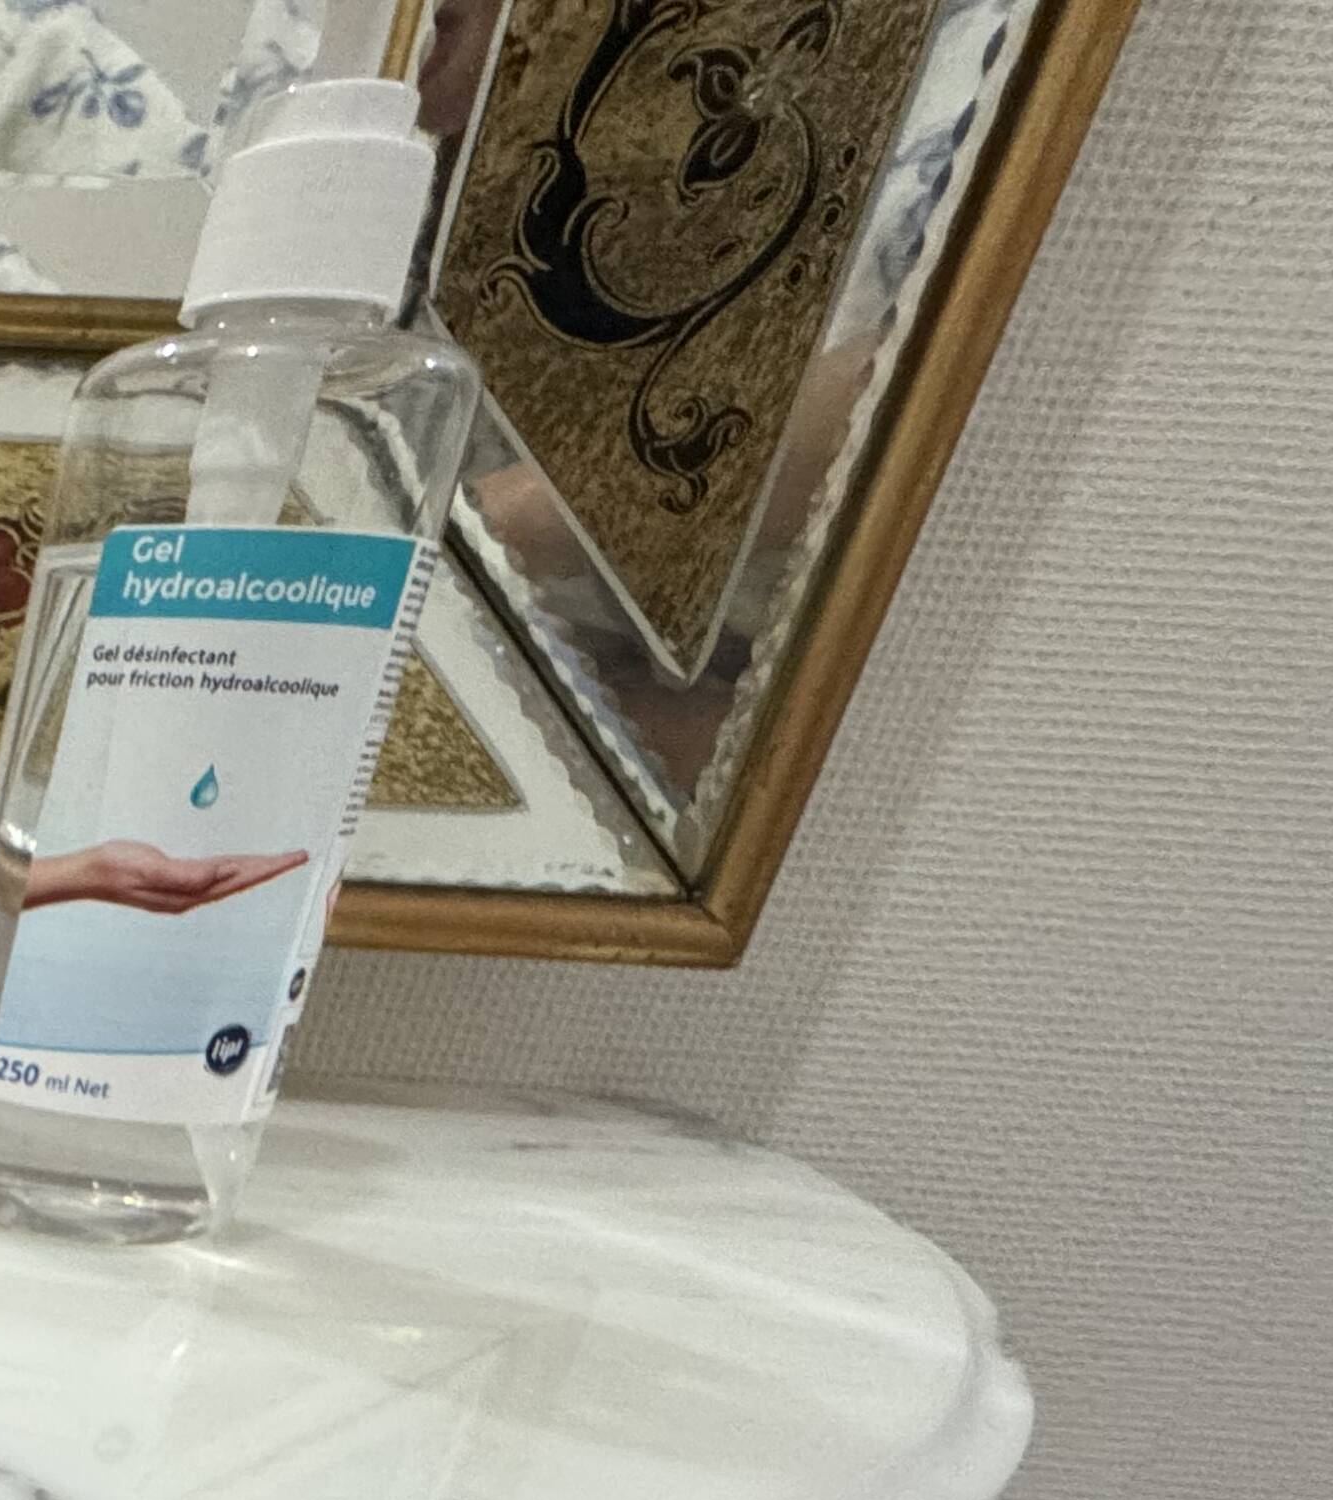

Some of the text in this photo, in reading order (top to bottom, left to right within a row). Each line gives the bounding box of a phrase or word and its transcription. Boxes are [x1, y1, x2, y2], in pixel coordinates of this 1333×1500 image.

[133, 535, 185, 563] Gel
[122, 571, 377, 613] hydroalcoolique
[92, 645, 236, 665] Gel désinfectant
[87, 670, 339, 699] pour friction hydroalcoolique
[45, 1074, 69, 1092] ml
[74, 1077, 110, 1098] Net
